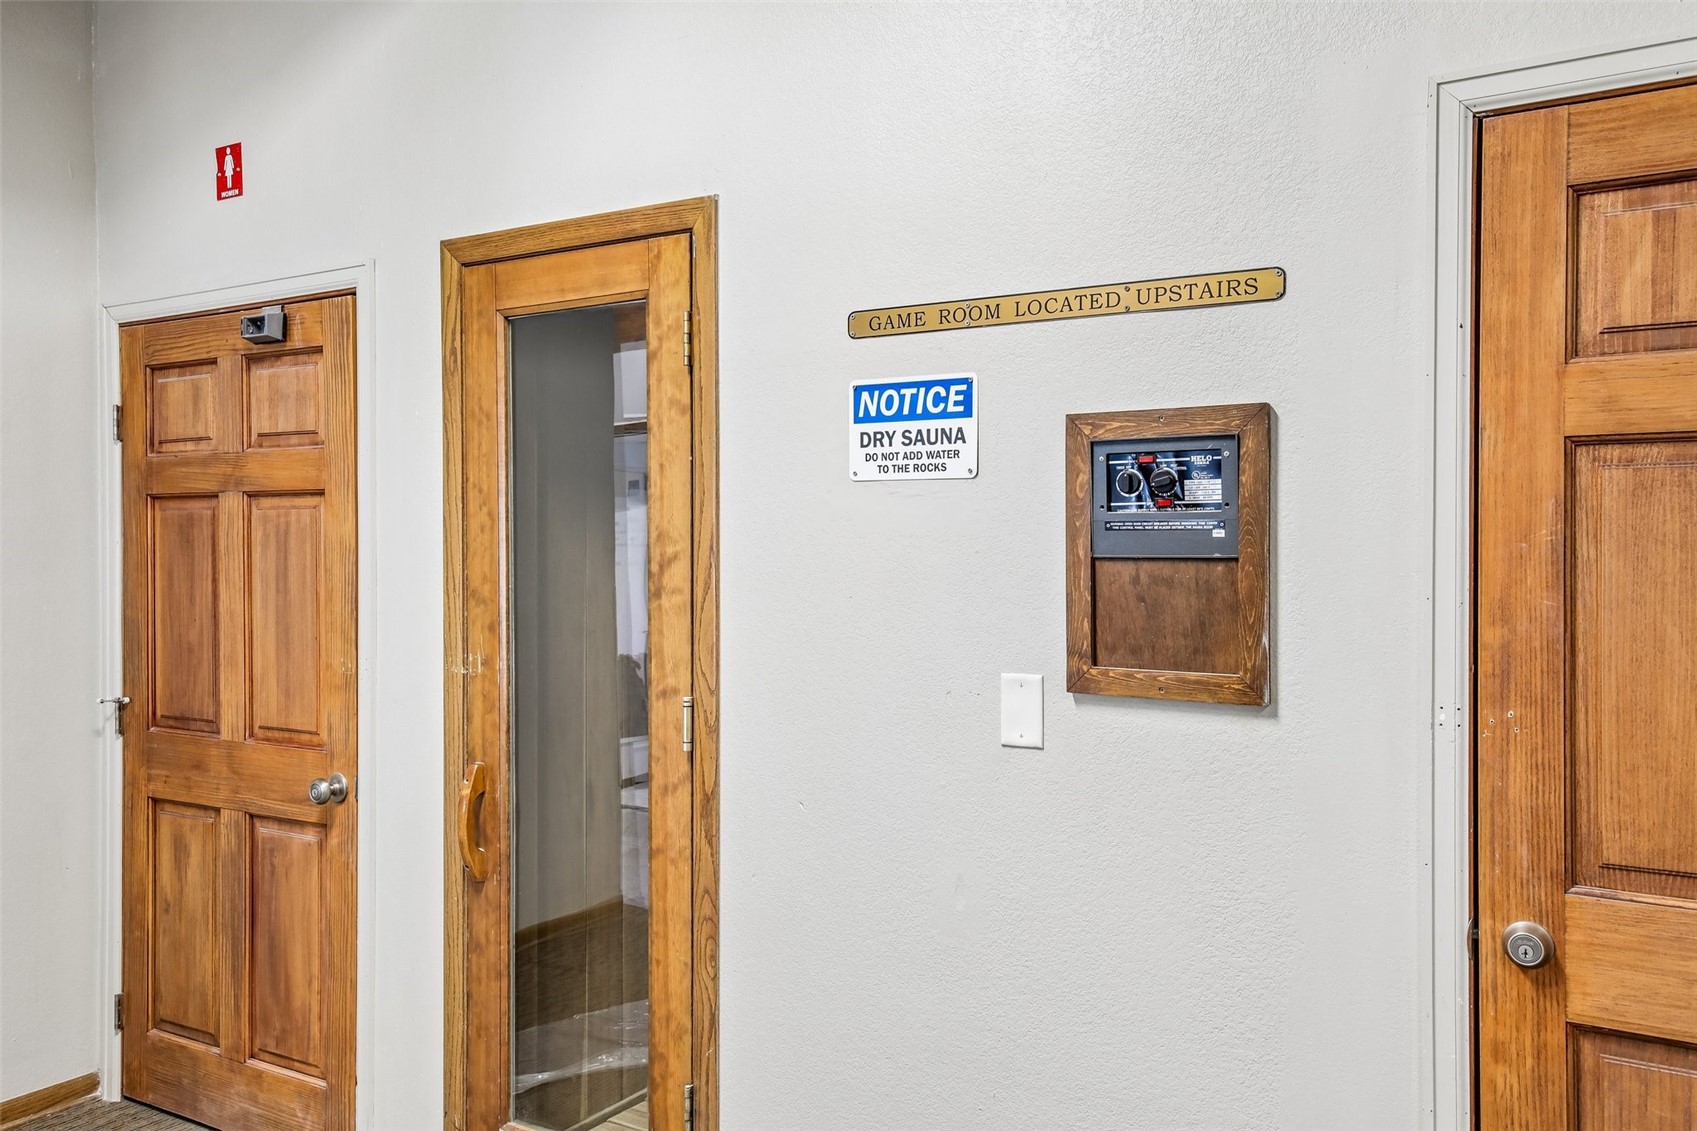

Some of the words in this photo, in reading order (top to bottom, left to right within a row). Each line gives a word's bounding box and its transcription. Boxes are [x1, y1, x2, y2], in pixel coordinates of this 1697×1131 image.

[221, 189, 239, 198] WOMEN
[868, 311, 926, 331] GAME
[938, 303, 1000, 324] ROOM
[1014, 291, 1121, 317] LOCATED
[1136, 277, 1259, 305] UPSTAIRS
[858, 384, 967, 418] NOTICE
[860, 430, 896, 448] DRY
[901, 426, 967, 446] SAUNA
[865, 452, 878, 462] DO
[881, 451, 900, 461] NOT
[902, 451, 923, 461] ADD
[926, 449, 960, 460] WATER
[877, 464, 889, 474] TO
[891, 463, 910, 473] THE
[913, 462, 947, 473] ROCKS
